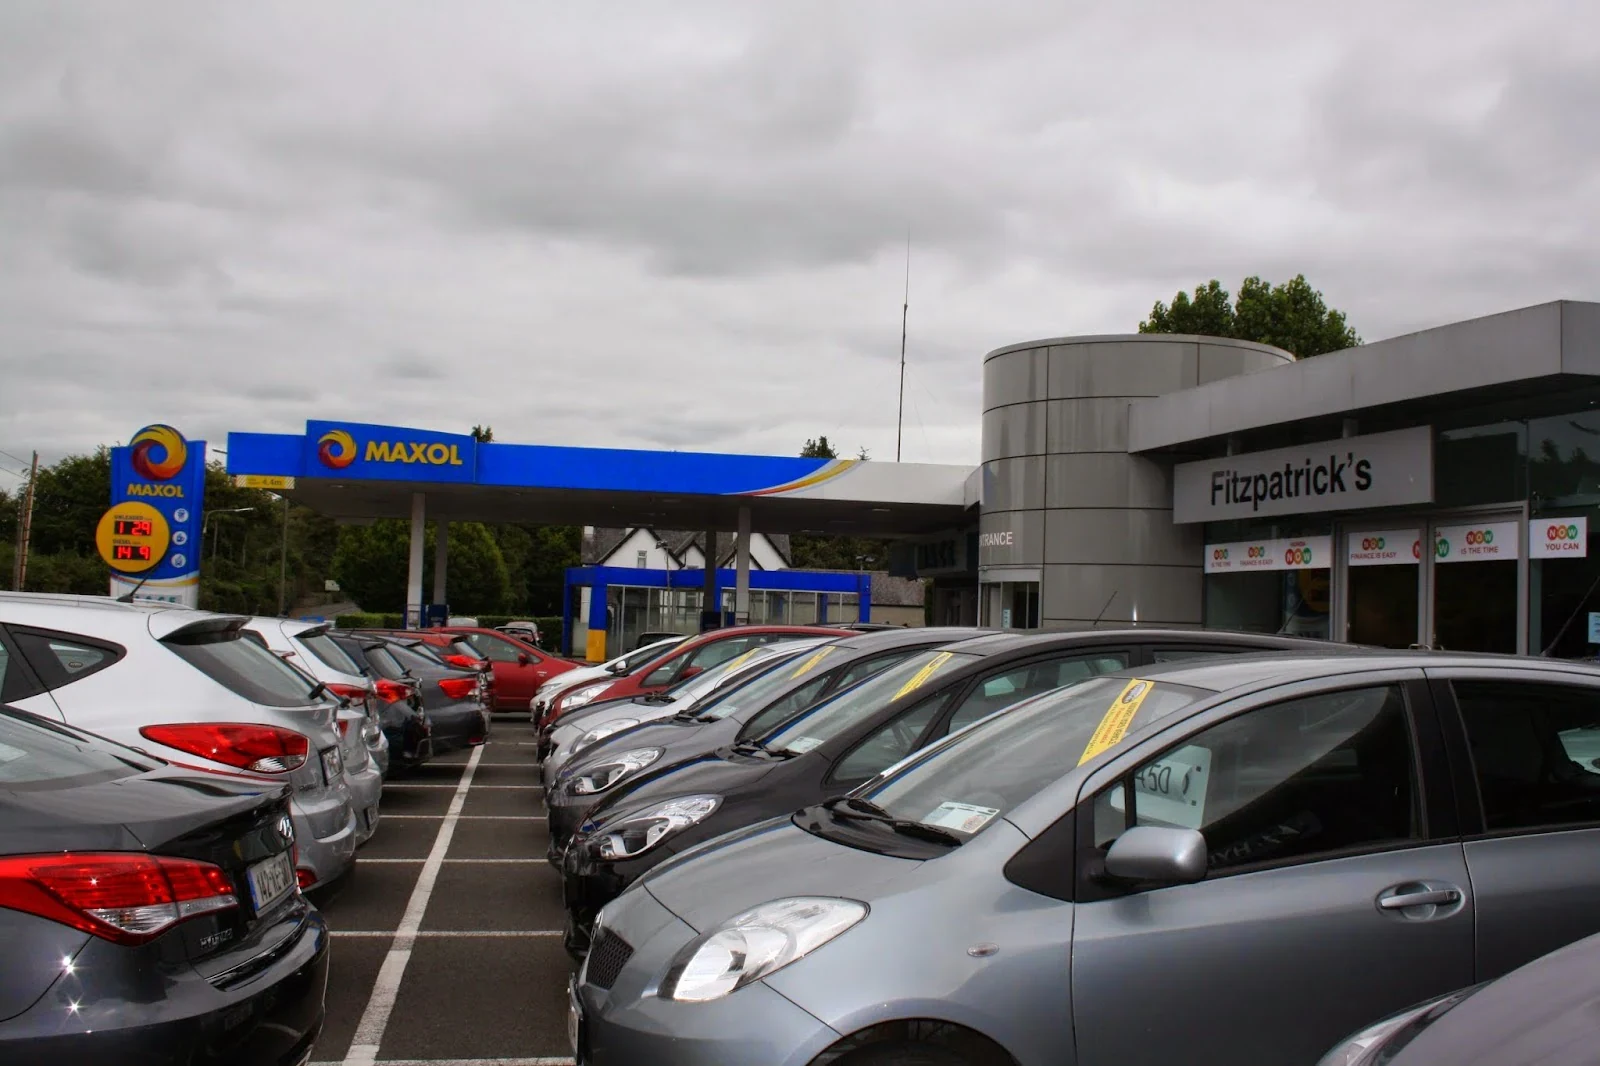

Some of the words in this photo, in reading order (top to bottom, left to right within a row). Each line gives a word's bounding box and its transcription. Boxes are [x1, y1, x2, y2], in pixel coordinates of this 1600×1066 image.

[365, 441, 463, 465] MAXOL
[1211, 452, 1372, 512] Fitzpatrick's
[127, 483, 184, 498] MAXOL
[1467, 532, 1493, 543] NOW
[1548, 526, 1577, 539] NOW
[1286, 549, 1311, 563] NOW
